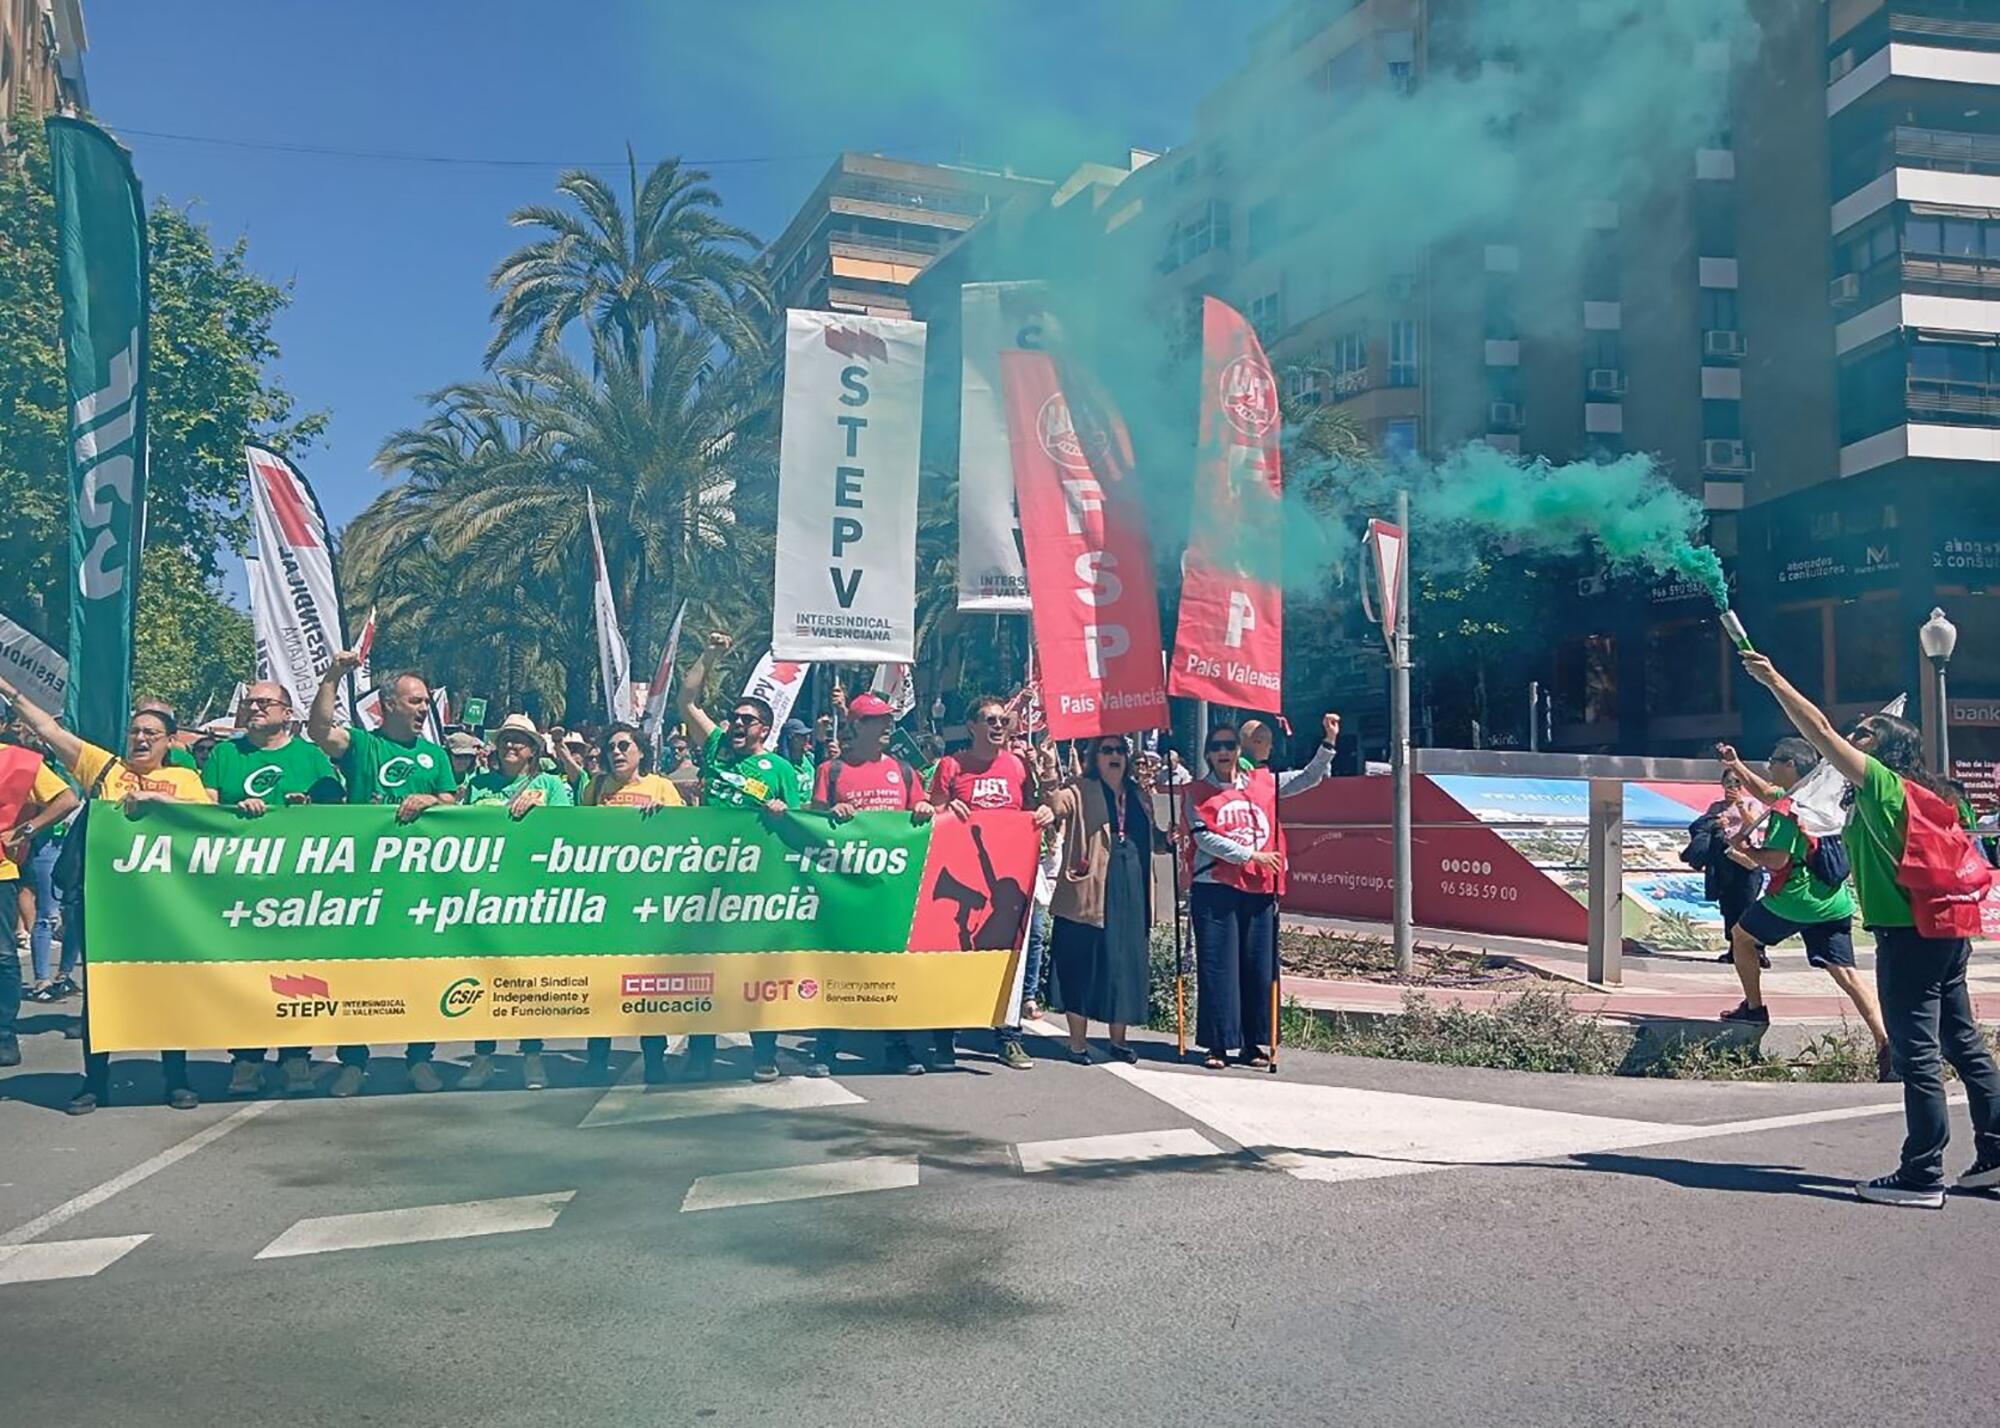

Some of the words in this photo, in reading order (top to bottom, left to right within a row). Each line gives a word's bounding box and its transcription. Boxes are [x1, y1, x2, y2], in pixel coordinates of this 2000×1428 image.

[828, 366, 871, 609] STEPV
[979, 574, 1026, 587] INTERS
[994, 588, 1031, 598] VALE
[796, 613, 892, 629] INTERSINDICAL
[811, 627, 891, 641] VALENCIANA
[1185, 654, 1222, 678] País
[1060, 692, 1096, 715] País
[973, 779, 1010, 798] UGT
[112, 836, 173, 873] JA
[295, 836, 358, 873] HA
[370, 836, 507, 874] PROU!
[530, 837, 763, 876] -burocràcia
[784, 840, 909, 875] -ràtios
[1292, 870, 1394, 892] www.servigroup.c
[1440, 881, 1456, 896] 96
[1458, 882, 1480, 899] 585
[1482, 884, 1497, 900] 59
[1500, 887, 1518, 901] 00
[221, 887, 384, 928] +salari
[407, 886, 608, 934] +plantilla
[631, 886, 820, 925] +valencià
[493, 977, 537, 988] Central
[540, 976, 589, 988] Sindical
[493, 991, 579, 1004] Independiente
[582, 993, 589, 1004] y
[743, 980, 794, 1001] UGT
[276, 1001, 339, 1018] STEPV
[341, 999, 406, 1008] INTERSINDICAL
[492, 1007, 508, 1017] de
[511, 1006, 590, 1017] Funcionarios
[621, 997, 713, 1013] educació
[352, 1008, 406, 1016] VALENCIANA
